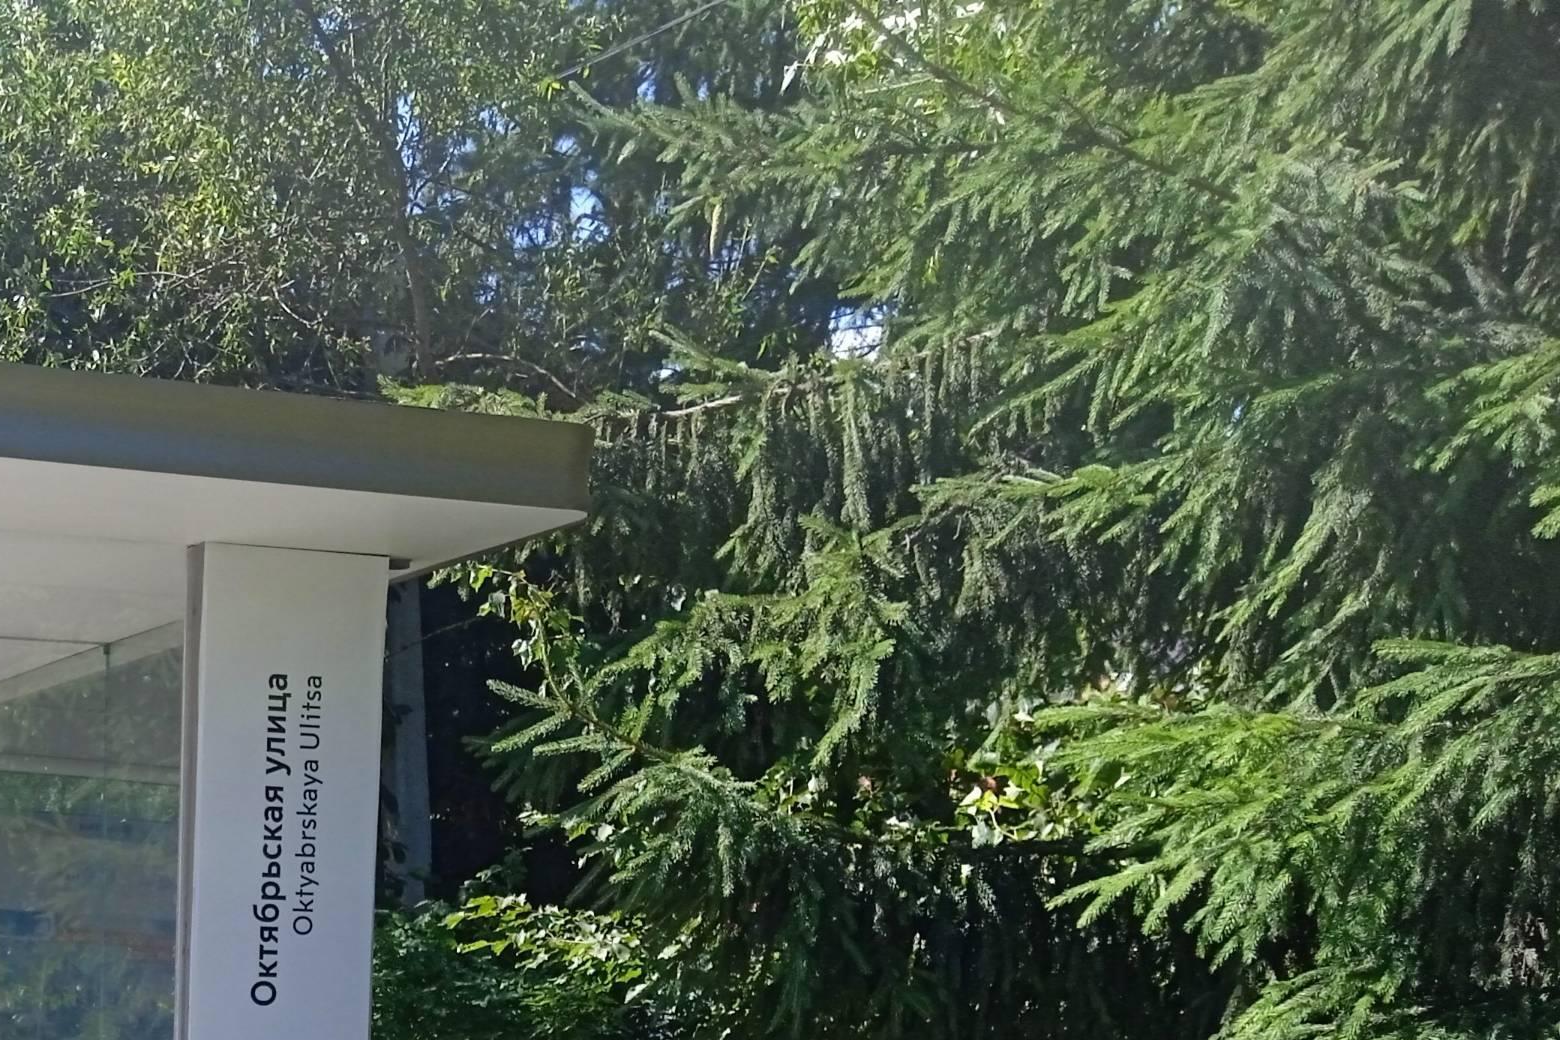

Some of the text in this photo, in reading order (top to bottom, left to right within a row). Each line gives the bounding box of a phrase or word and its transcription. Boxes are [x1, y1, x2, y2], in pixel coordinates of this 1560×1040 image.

[250, 672, 292, 1007] Октябрьская улица
[292, 675, 323, 936] Oktyabrskaya Ulitsa
